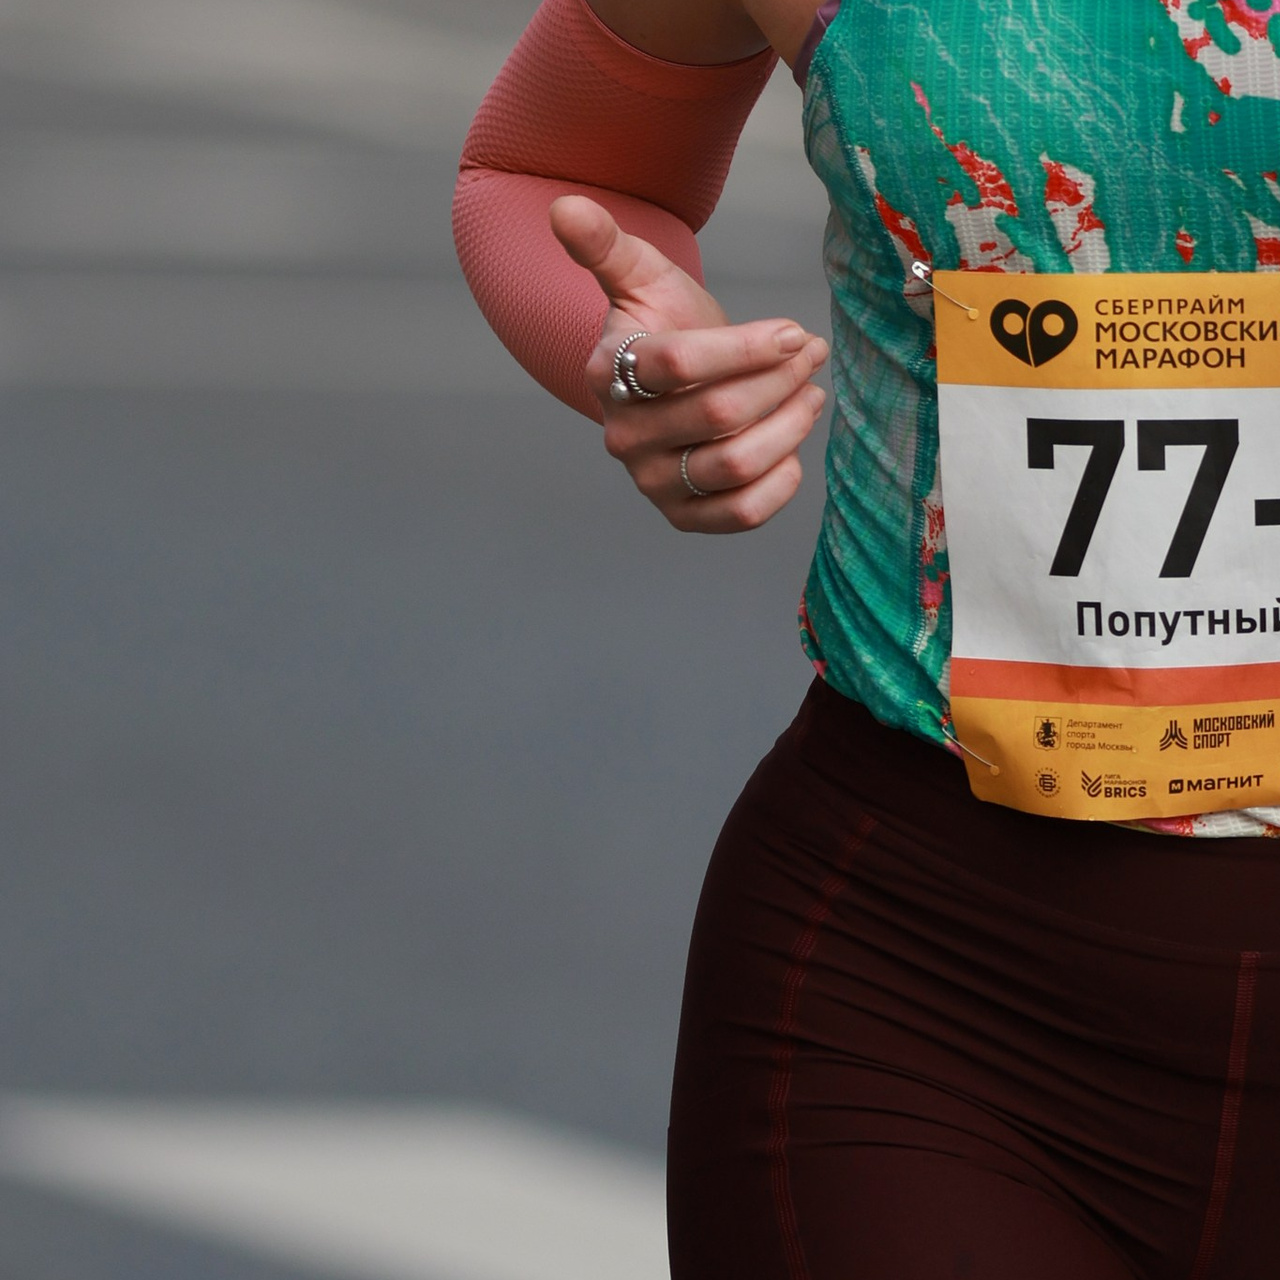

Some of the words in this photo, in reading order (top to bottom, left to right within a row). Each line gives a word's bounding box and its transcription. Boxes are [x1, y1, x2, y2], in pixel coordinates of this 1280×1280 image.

[1095, 295, 1245, 315] СБЕРПРАЙМ
[1095, 348, 1246, 370] МАРАФОН
[1067, 719, 1122, 729] Департамент
[1193, 710, 1275, 733] МОСКОВСКИЙ
[1067, 731, 1095, 739] спорта
[1193, 733, 1231, 749] СПОРТ
[1067, 742, 1095, 750] города
[1104, 787, 1147, 798] BRICS
